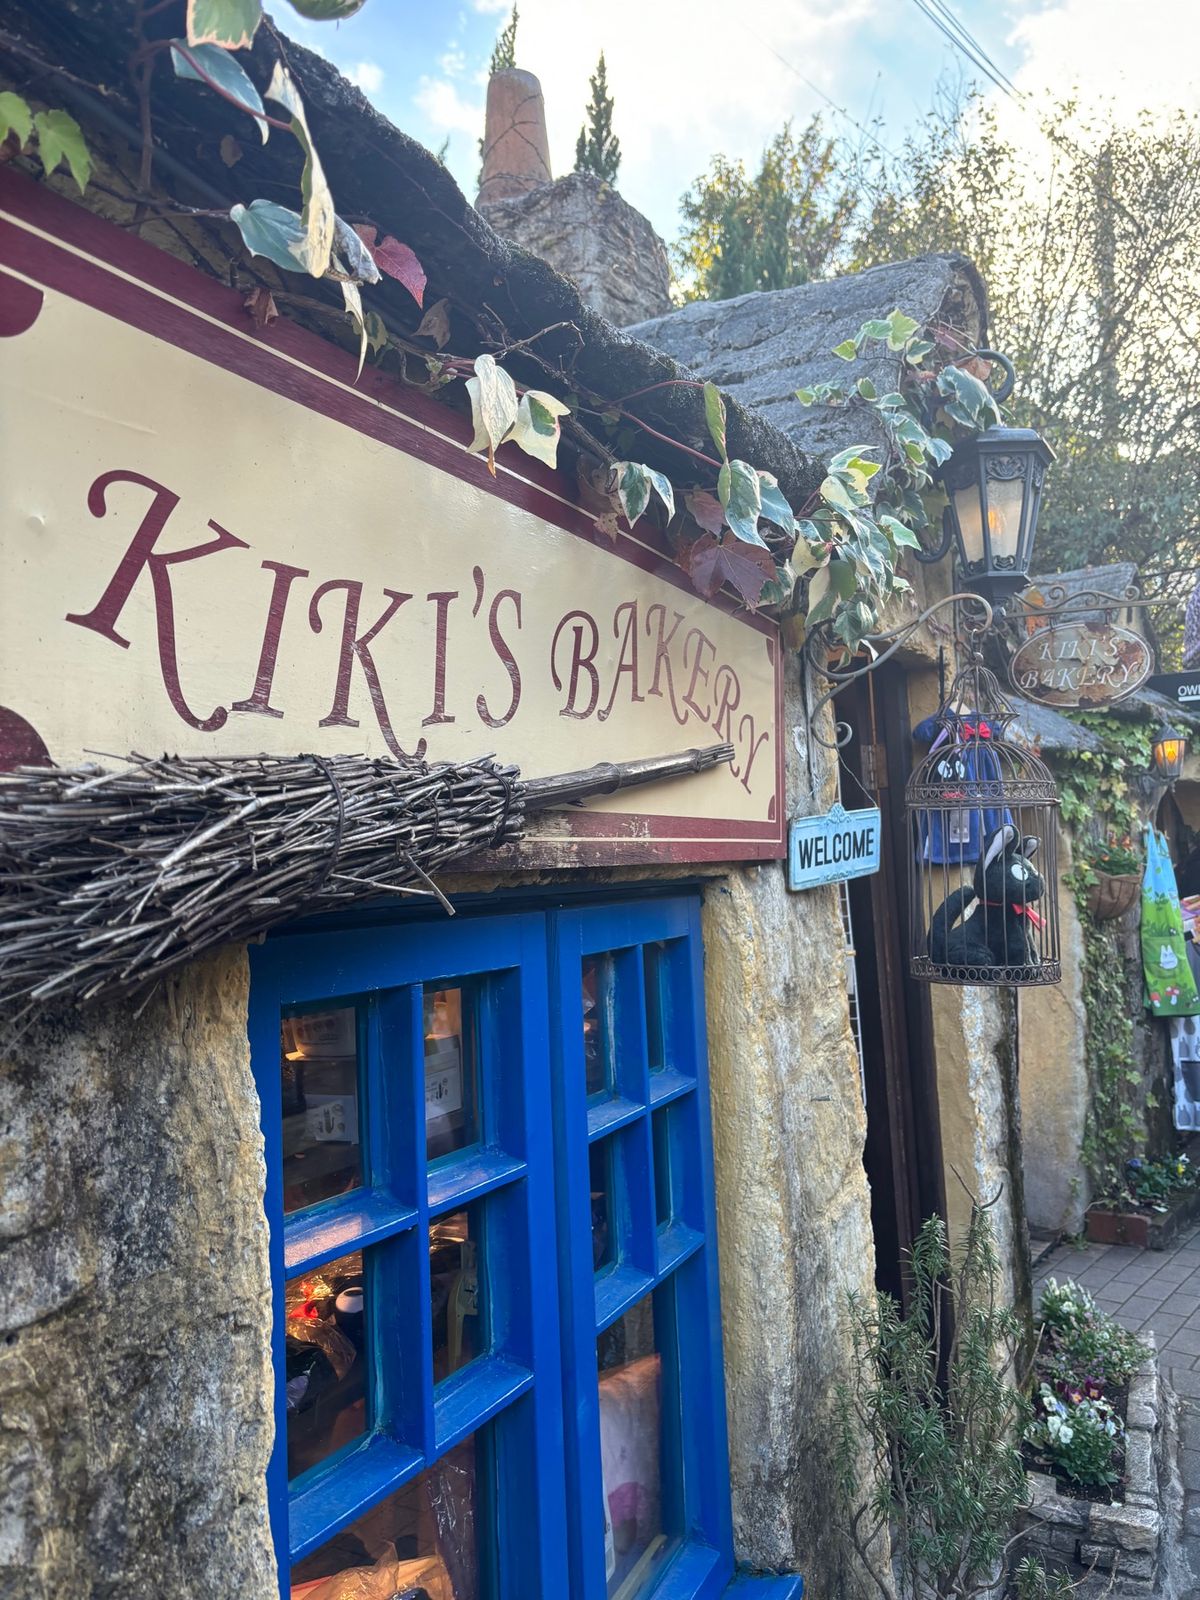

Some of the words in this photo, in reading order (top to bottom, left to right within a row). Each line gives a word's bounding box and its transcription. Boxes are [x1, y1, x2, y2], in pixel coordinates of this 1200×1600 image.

[66, 469, 522, 764] KIKI'S
[551, 599, 769, 794] BAKERY
[1038, 635, 1120, 662] KIKI'S
[1020, 661, 1138, 691] BAKERY
[1178, 684, 1200, 696] OW
[798, 828, 874, 870] WELCOME
